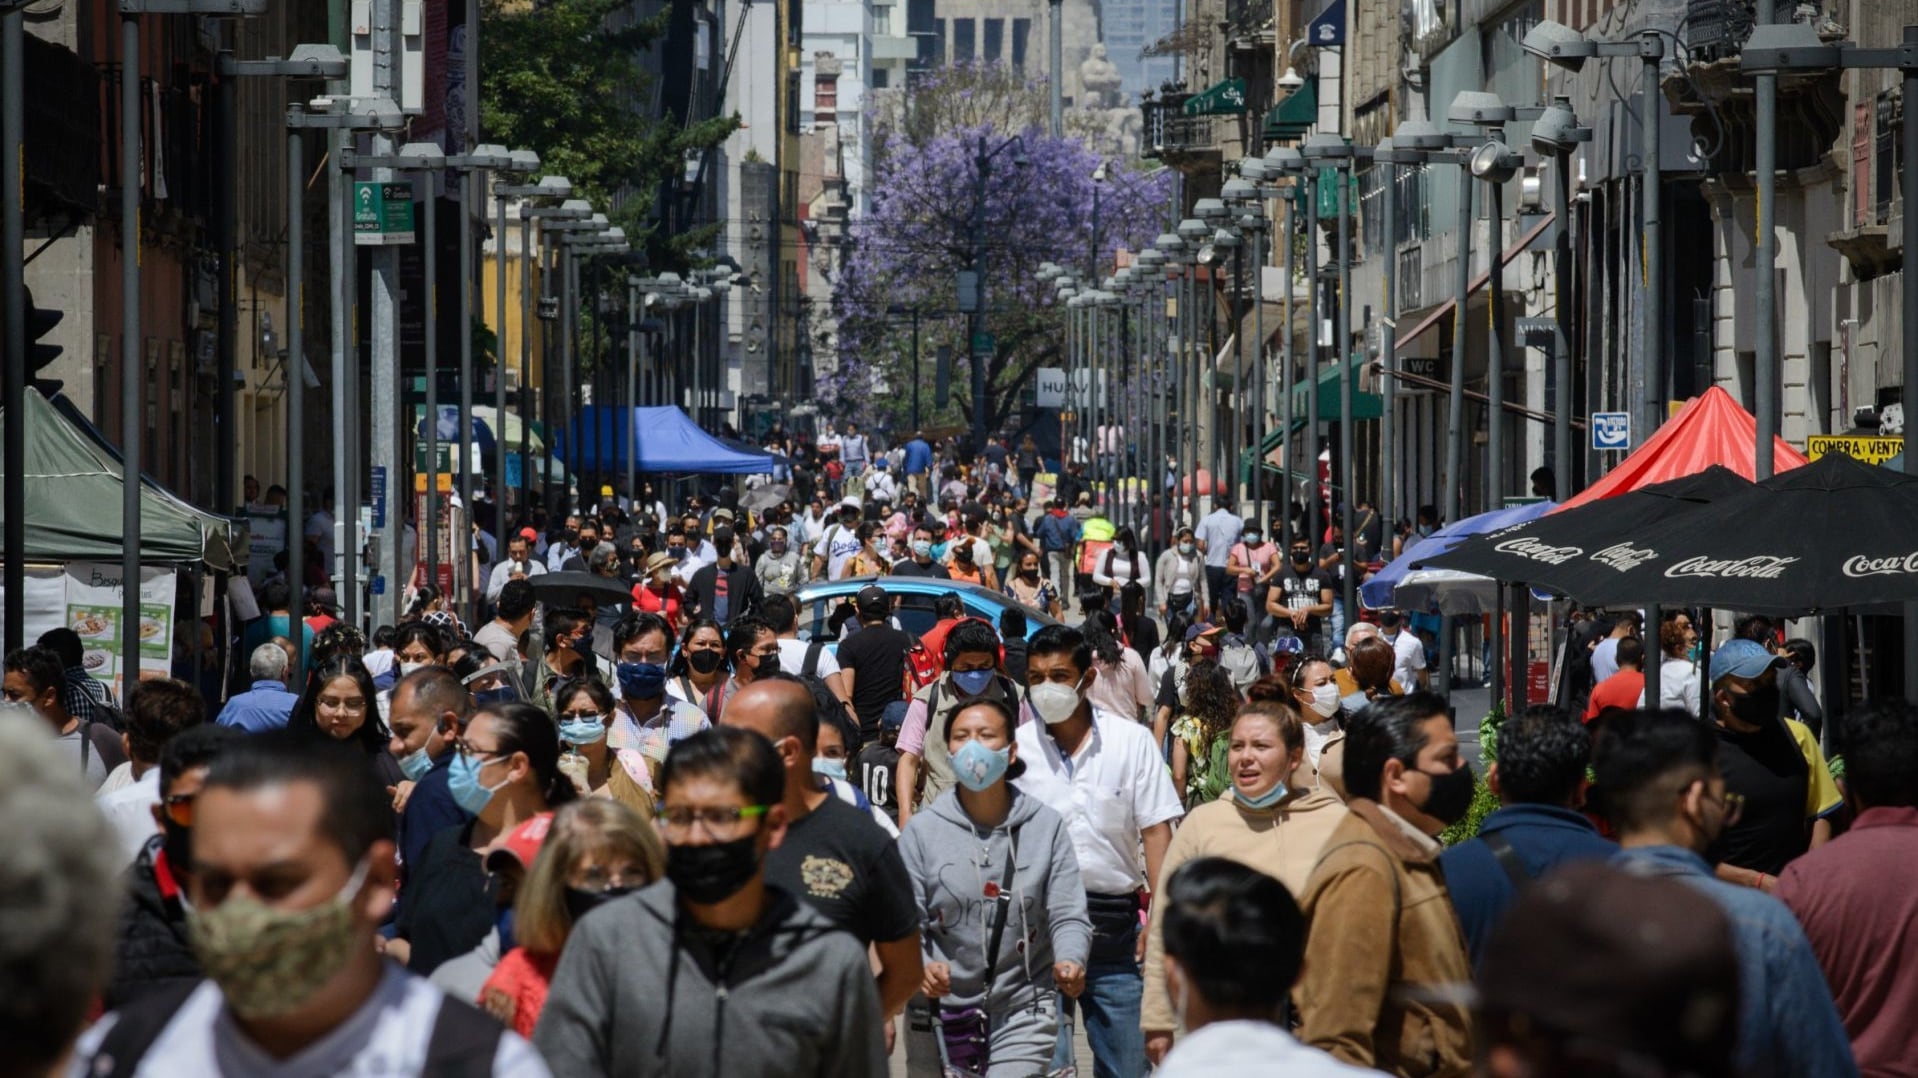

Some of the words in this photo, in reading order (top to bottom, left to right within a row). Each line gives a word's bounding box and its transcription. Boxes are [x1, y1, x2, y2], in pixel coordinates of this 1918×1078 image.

[1411, 360, 1434, 373] WC
[1812, 439, 1861, 455] COMPRA
[1494, 536, 1584, 566] Coca-Cola
[1589, 541, 1660, 573] Coca-Cola
[1664, 555, 1801, 579] Coca-Cola
[1842, 554, 1918, 577] Coca-C
[863, 762, 888, 806] 10
